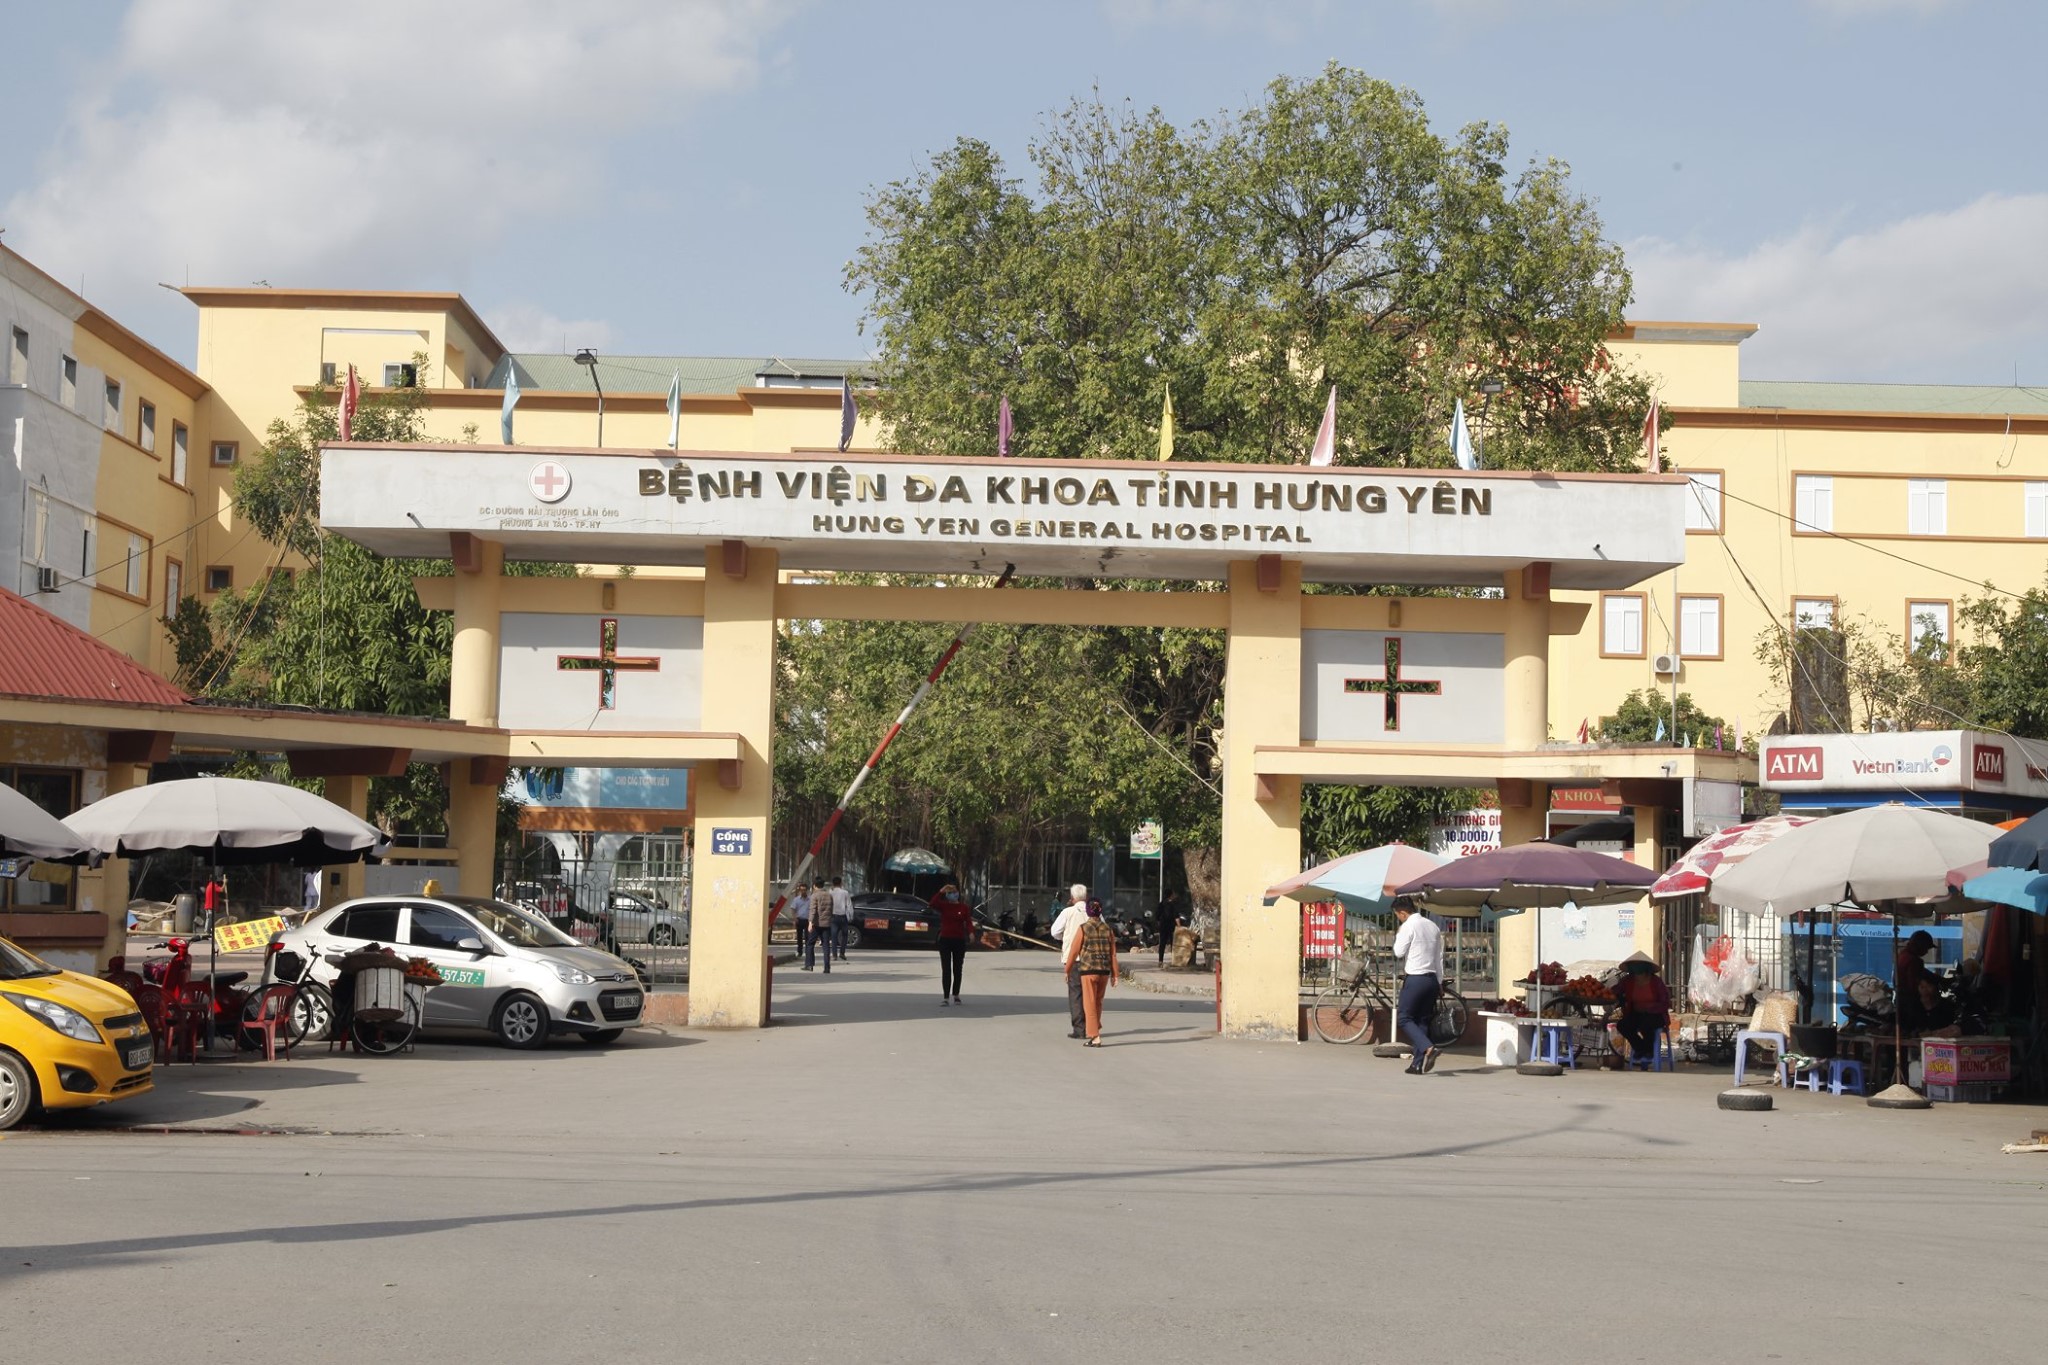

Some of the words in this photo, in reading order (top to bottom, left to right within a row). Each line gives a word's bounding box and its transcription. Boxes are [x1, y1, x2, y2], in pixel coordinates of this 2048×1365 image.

[639, 463, 761, 503] BỆNH
[776, 465, 887, 506] VIỆN
[903, 475, 972, 503] ĐA
[986, 476, 1120, 506] KHOA
[1128, 470, 1237, 509] TỈNH
[1254, 480, 1387, 513] HƯNG
[1397, 480, 1491, 515] YÊN
[813, 514, 904, 533] HUNG
[914, 517, 980, 536] YEN
[990, 519, 1142, 539] GENERAL
[1152, 522, 1311, 543] HOSPITAL
[1770, 753, 1818, 774] ATM
[1976, 752, 2002, 774] ATM
[1565, 791, 1602, 802] KHOA
[719, 842, 734, 852] SỐ
[738, 845, 744, 853] 1
